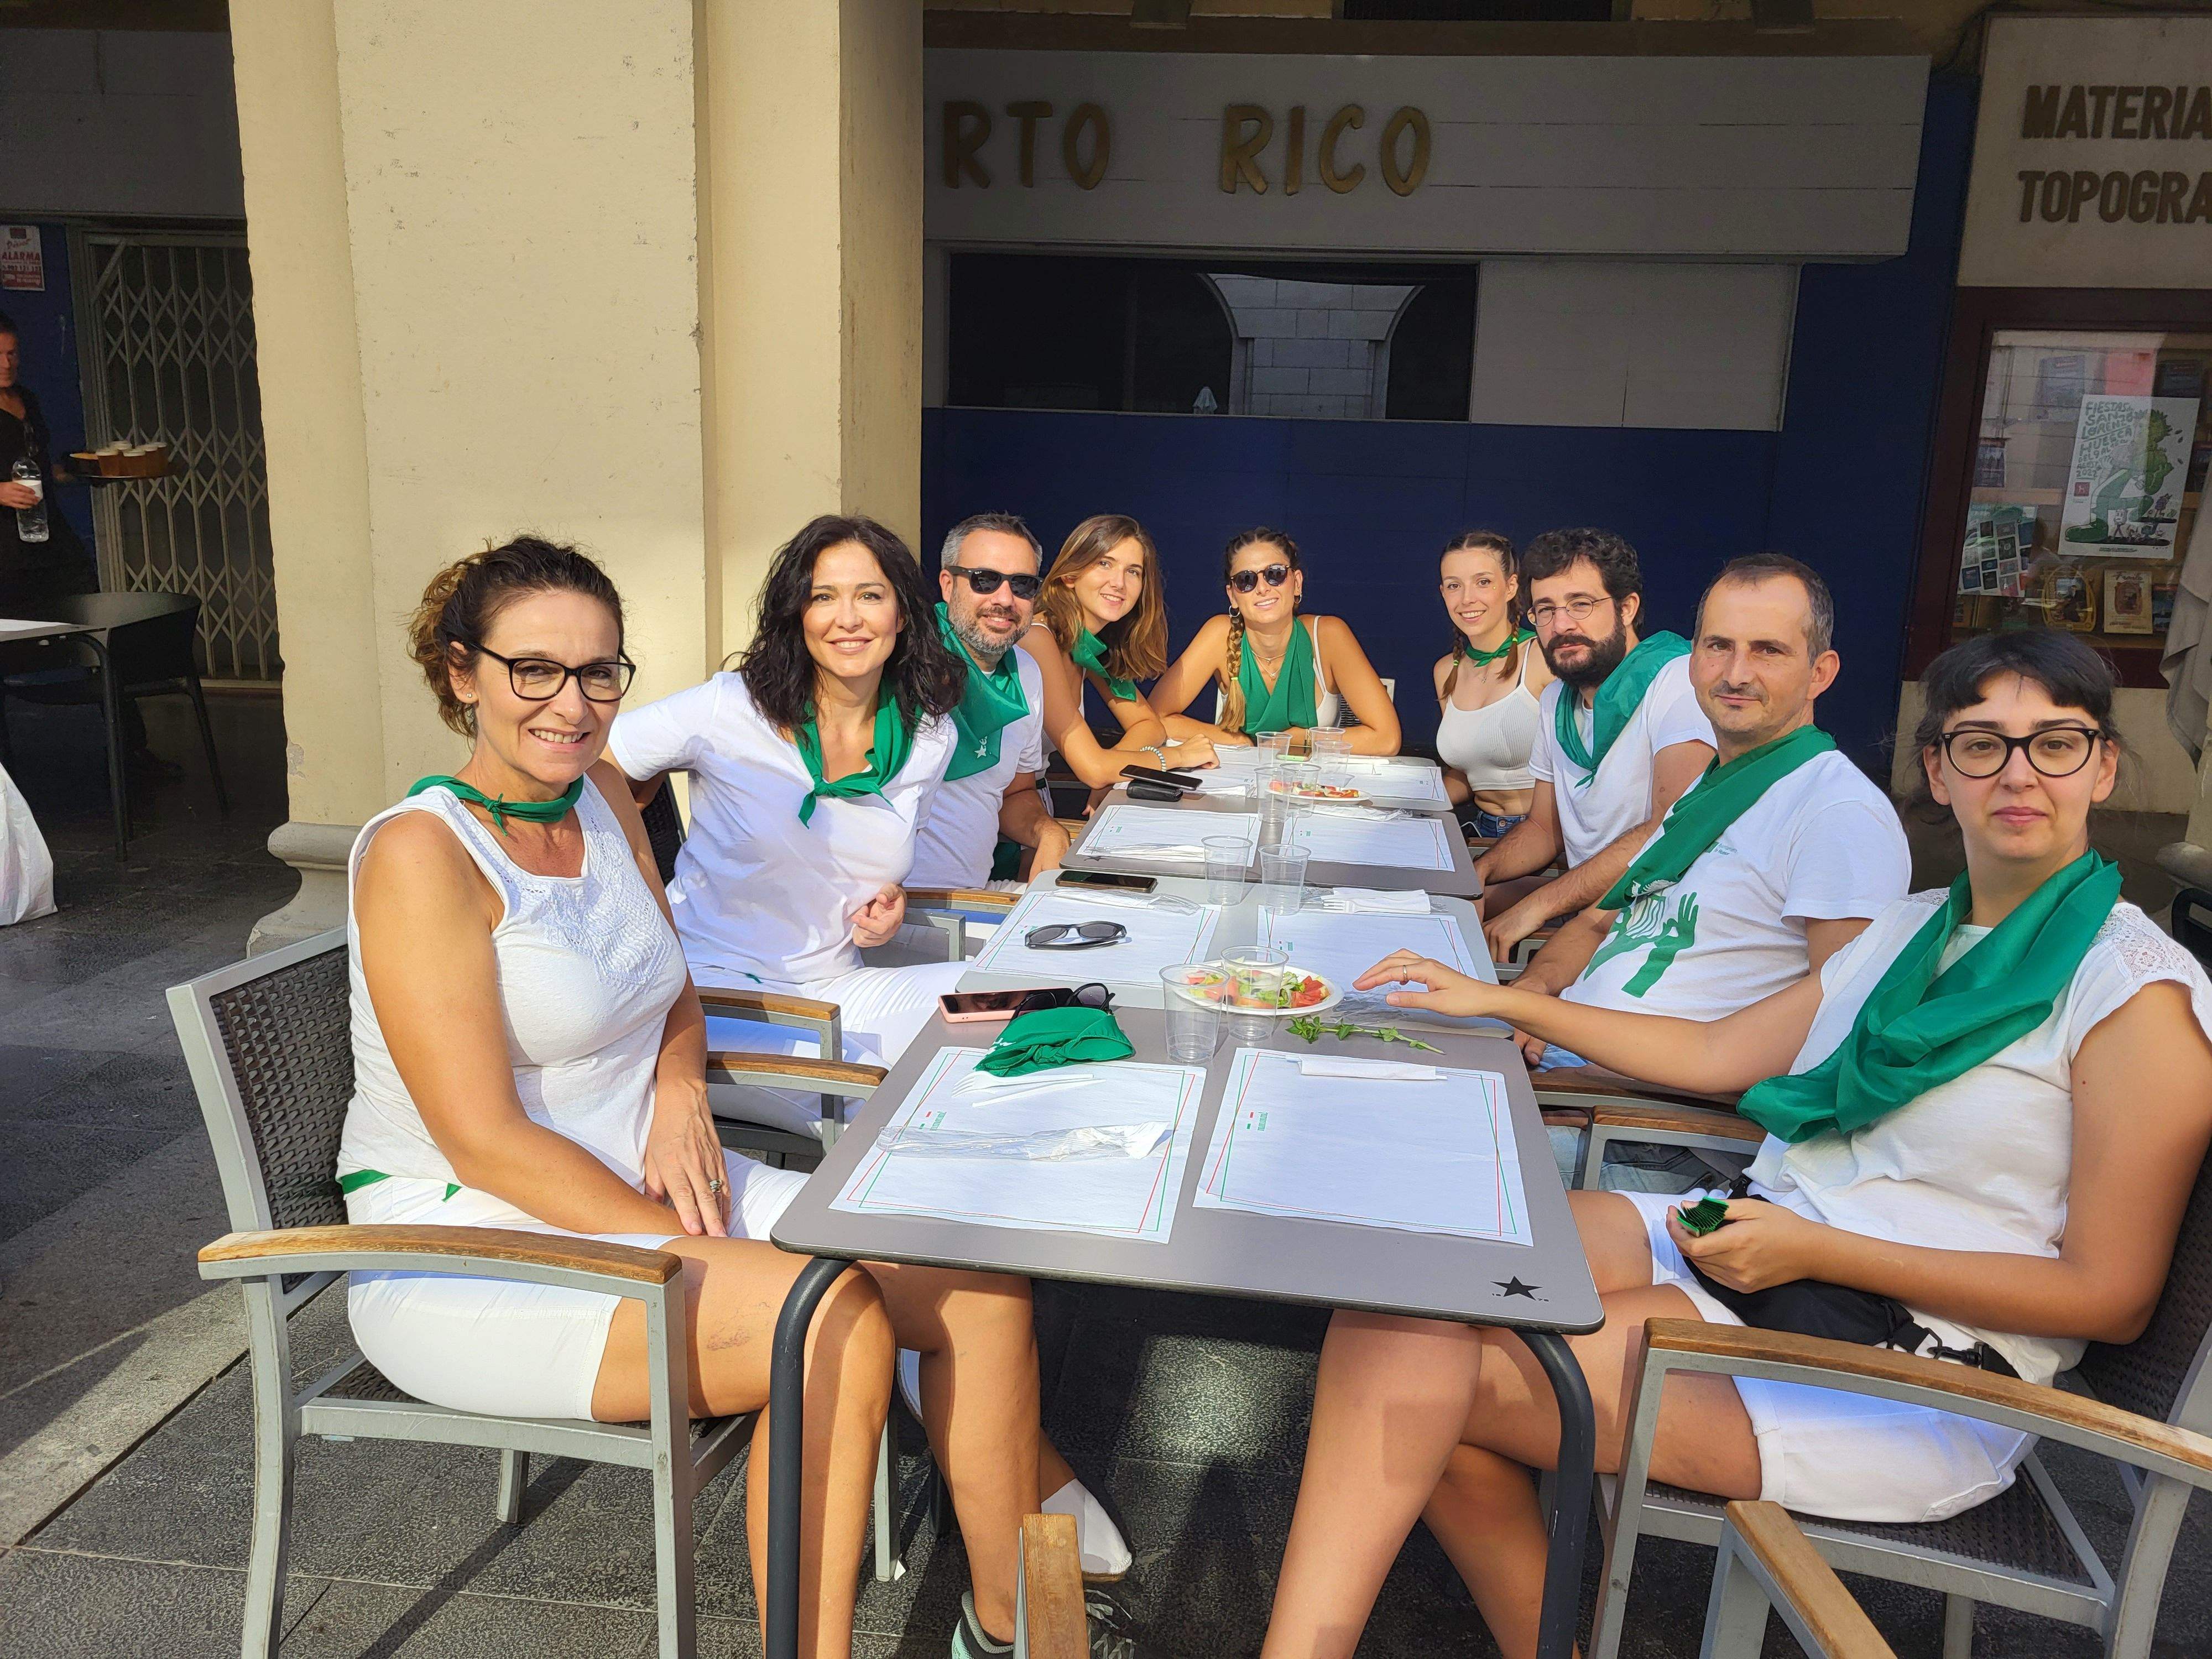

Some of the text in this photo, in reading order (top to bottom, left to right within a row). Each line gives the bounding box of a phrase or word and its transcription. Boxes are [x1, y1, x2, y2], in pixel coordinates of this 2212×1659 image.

[2022, 85, 2212, 139] MATERIA
[1219, 103, 1431, 196] RICO
[2018, 170, 2212, 223] TOPOGRA
[2, 252, 40, 260] ALARMA
[2085, 401, 2129, 416] FIESTAS
